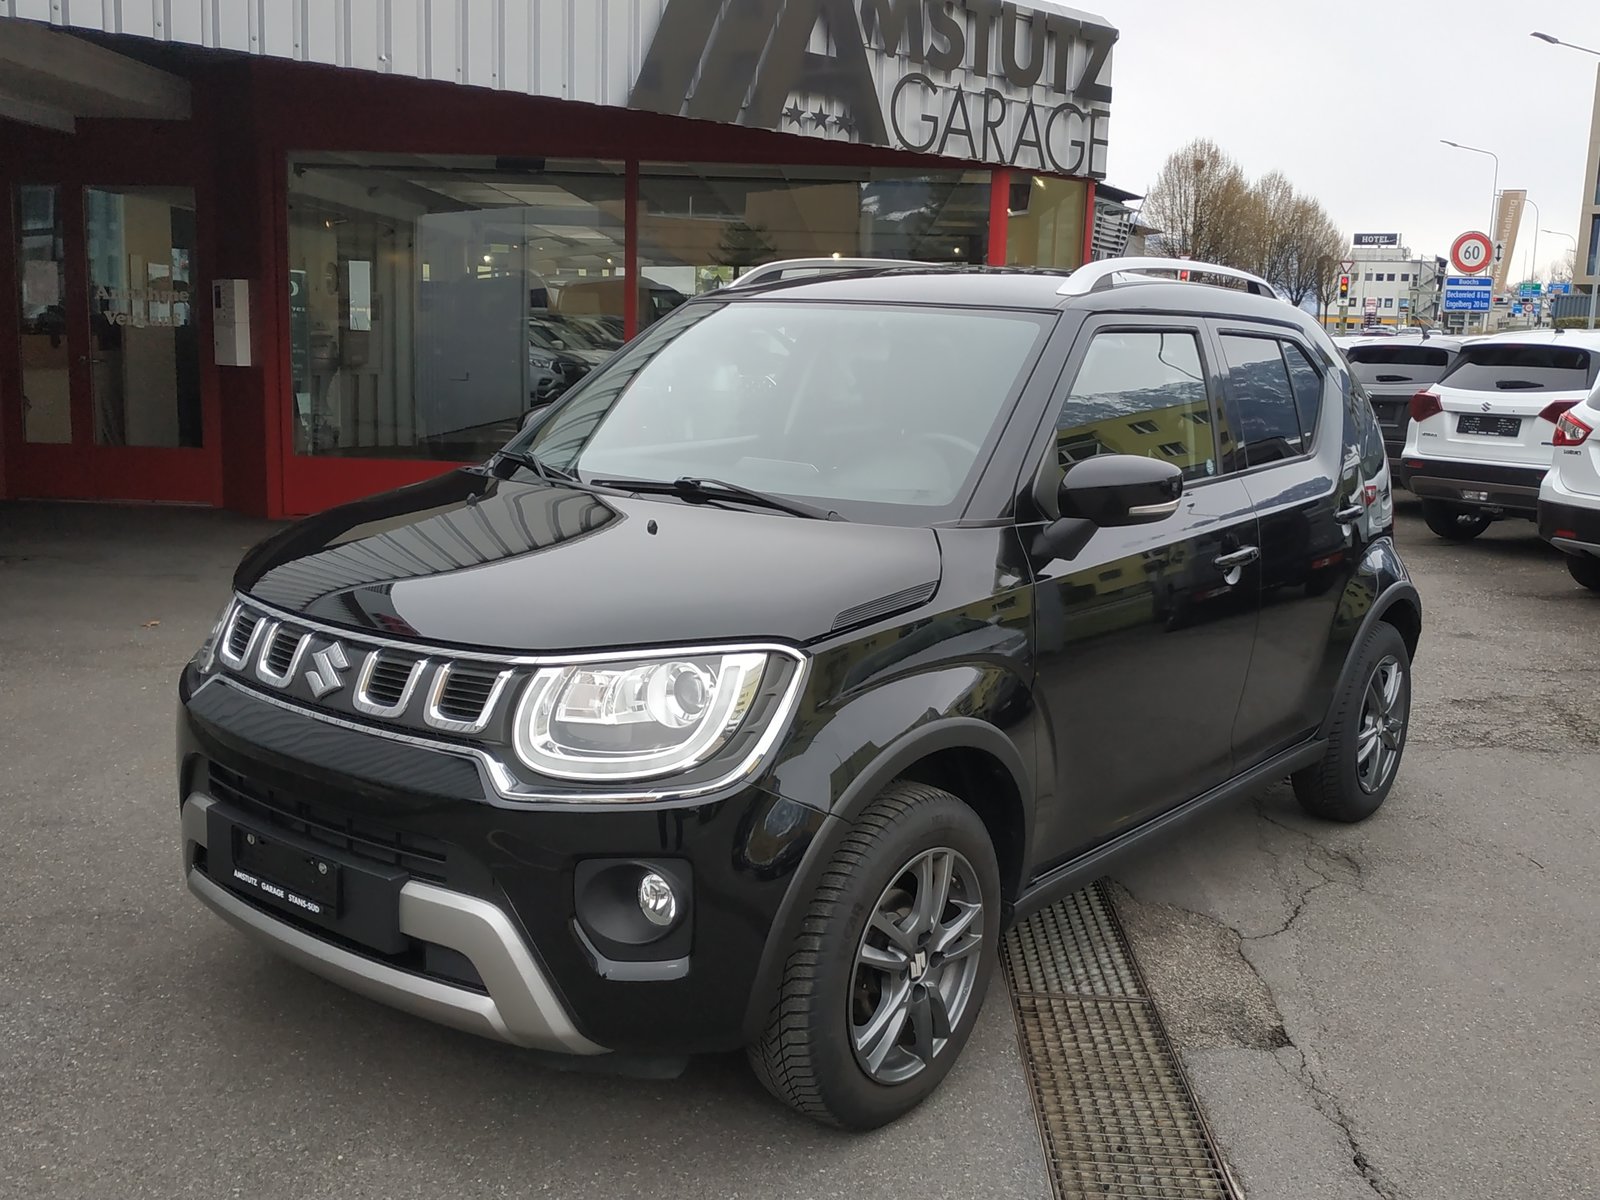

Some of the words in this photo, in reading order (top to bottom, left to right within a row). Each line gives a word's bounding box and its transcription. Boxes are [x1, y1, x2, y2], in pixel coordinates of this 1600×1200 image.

[890, 73, 1111, 181] GARAGE
[1361, 235, 1390, 243] HOTEL
[1464, 245, 1480, 260] 60
[1446, 300, 1472, 309] Engelberg
[234, 869, 258, 886] AMSTUTZ
[261, 882, 284, 898] GARAGE
